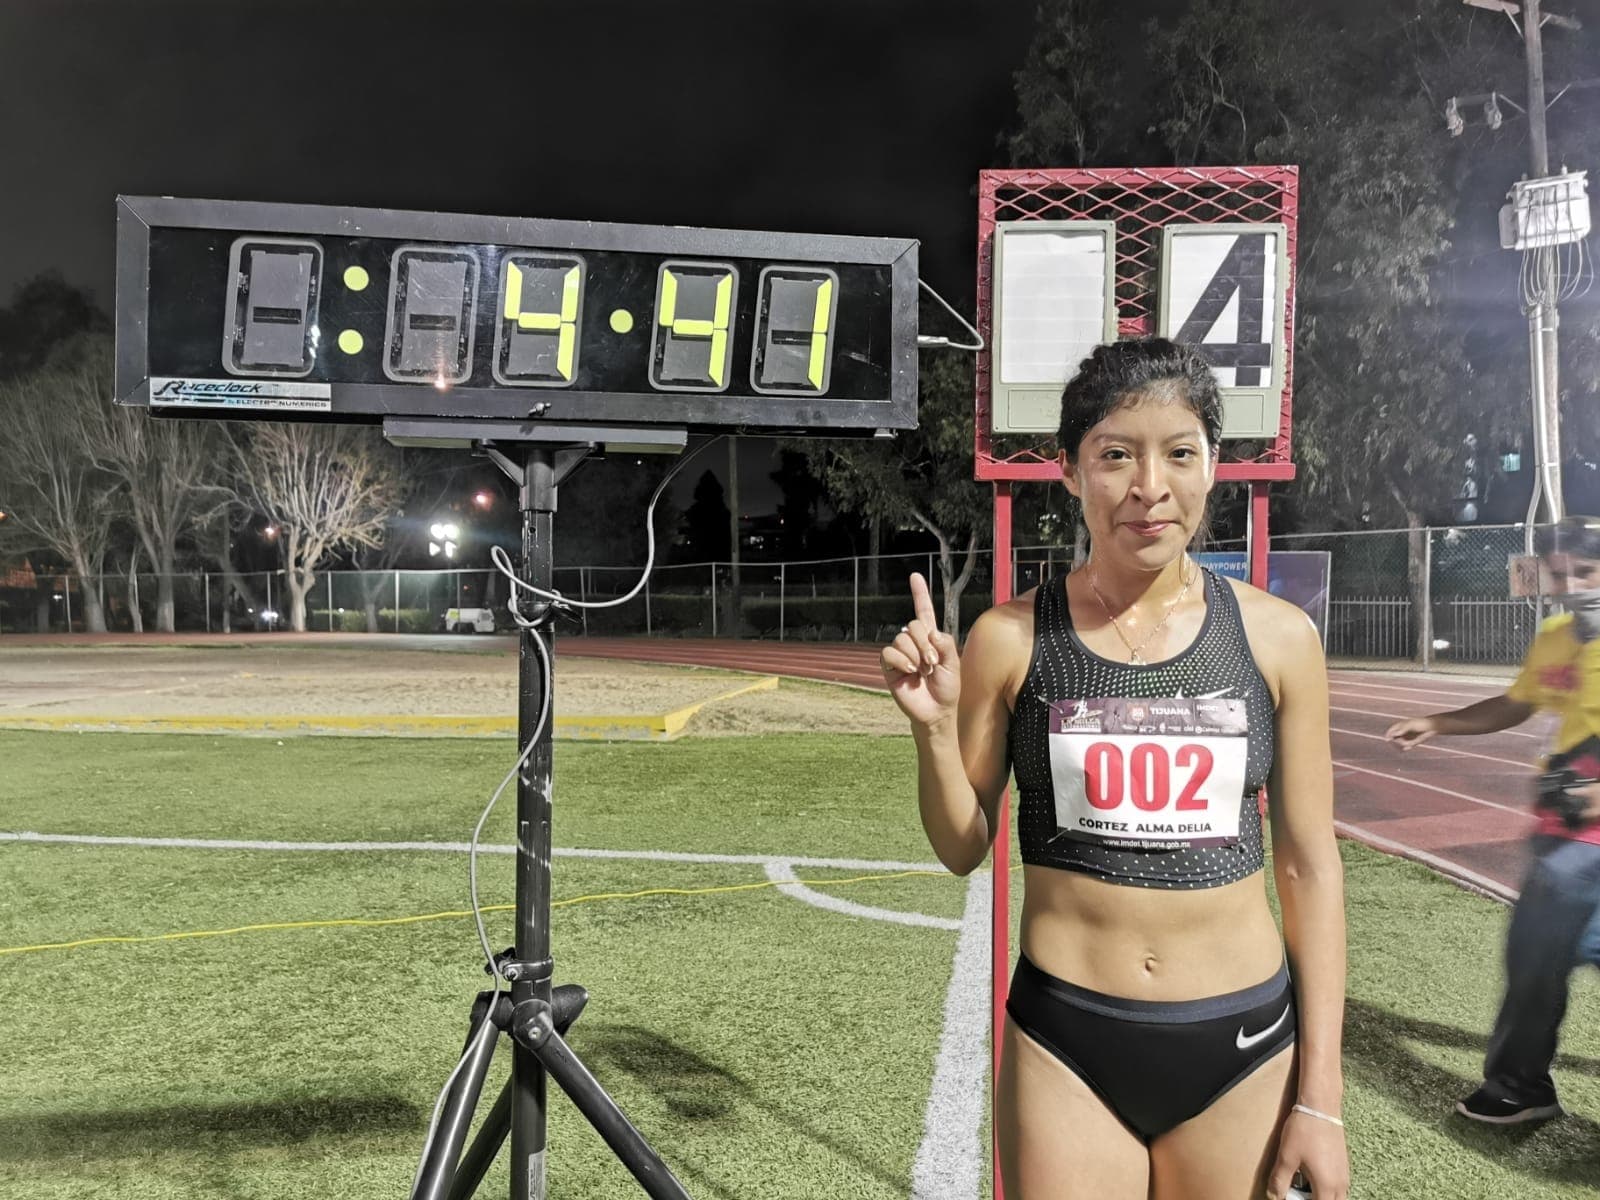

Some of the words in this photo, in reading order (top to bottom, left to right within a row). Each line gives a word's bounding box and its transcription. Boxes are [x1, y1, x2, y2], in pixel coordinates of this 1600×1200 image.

[1174, 233, 1272, 387] 4
[1149, 706, 1191, 716] TIJUANA
[1084, 741, 1214, 812] 002
[1079, 817, 1129, 832] CORTEZ
[1136, 823, 1175, 834] ALMA
[1178, 822, 1213, 833] DELIA
